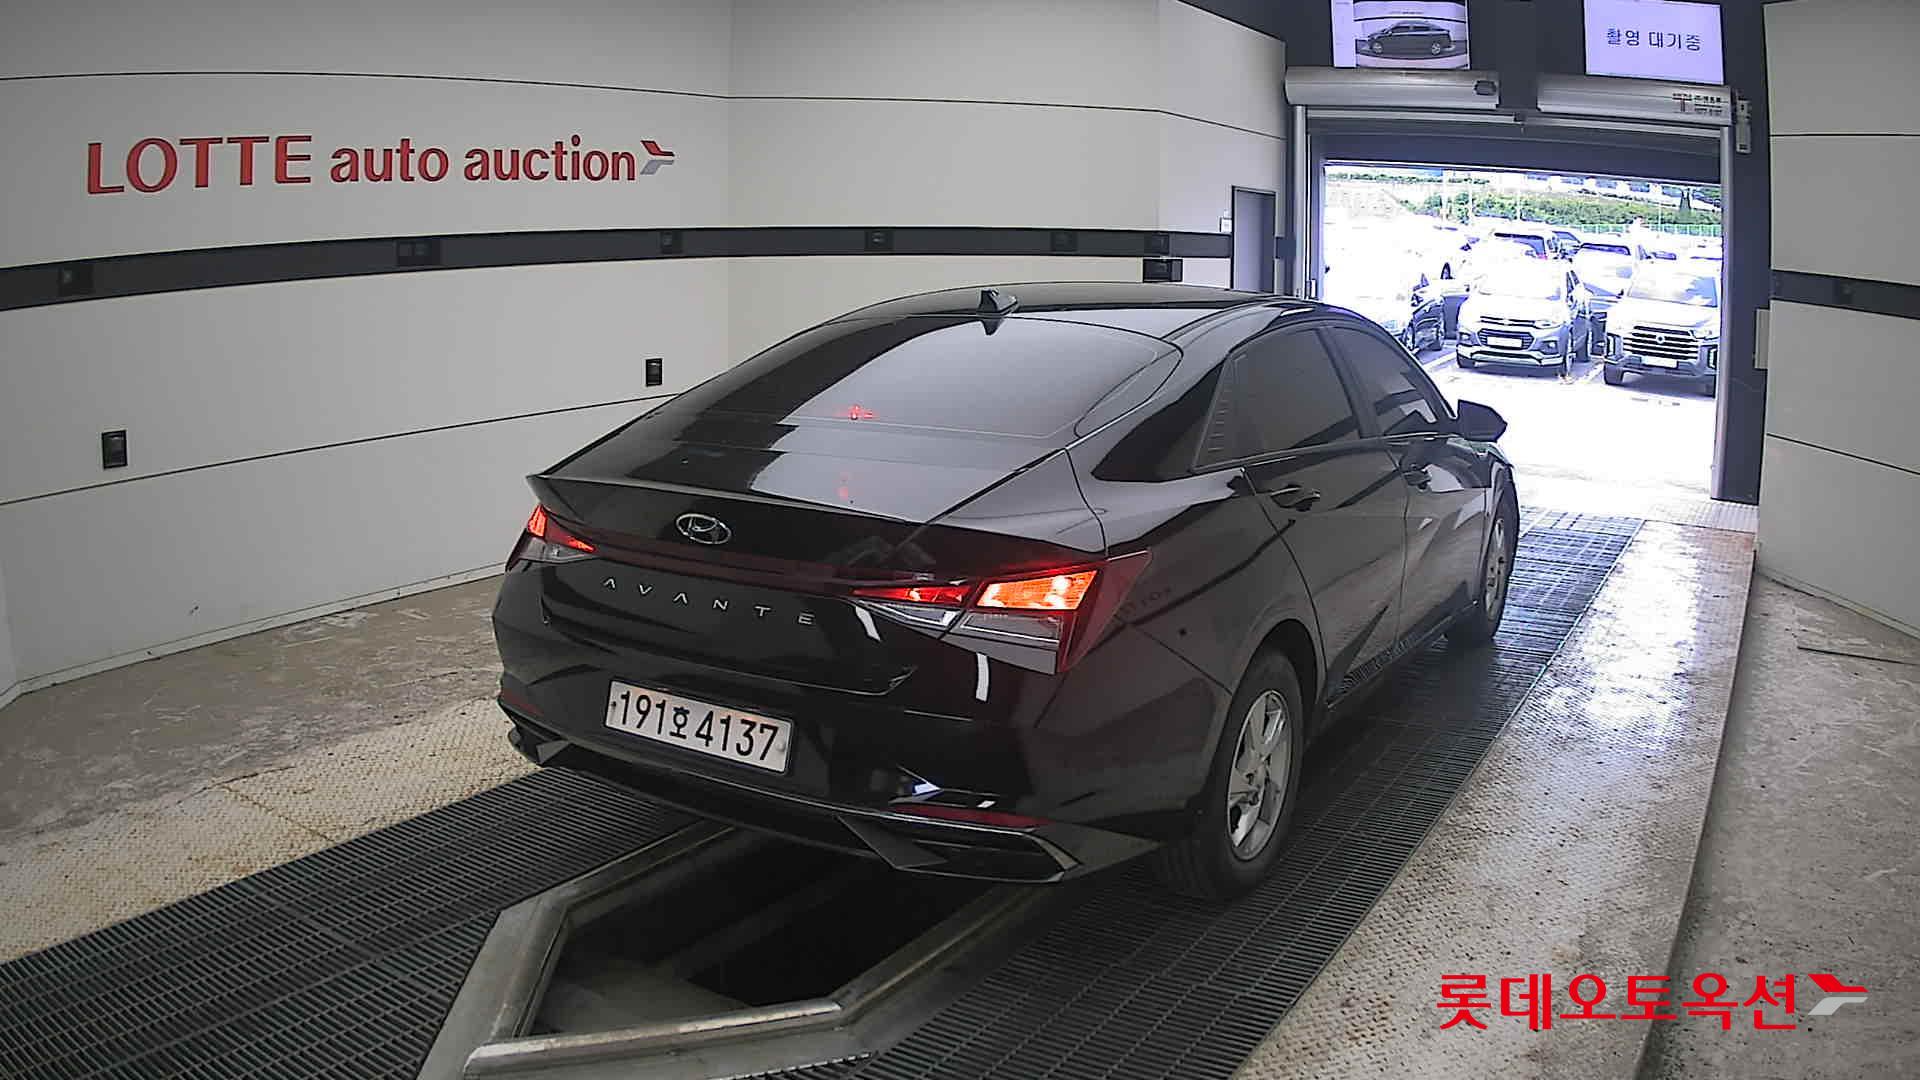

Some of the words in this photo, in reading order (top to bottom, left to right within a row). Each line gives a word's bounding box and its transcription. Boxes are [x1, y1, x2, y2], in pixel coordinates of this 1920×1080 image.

[1607, 28, 1640, 46] 촬영
[1648, 31, 1701, 51] 대기중
[88, 134, 313, 194] LOTTE
[331, 139, 450, 184] auto
[463, 134, 637, 182] auction
[603, 578, 815, 625] AVANTE
